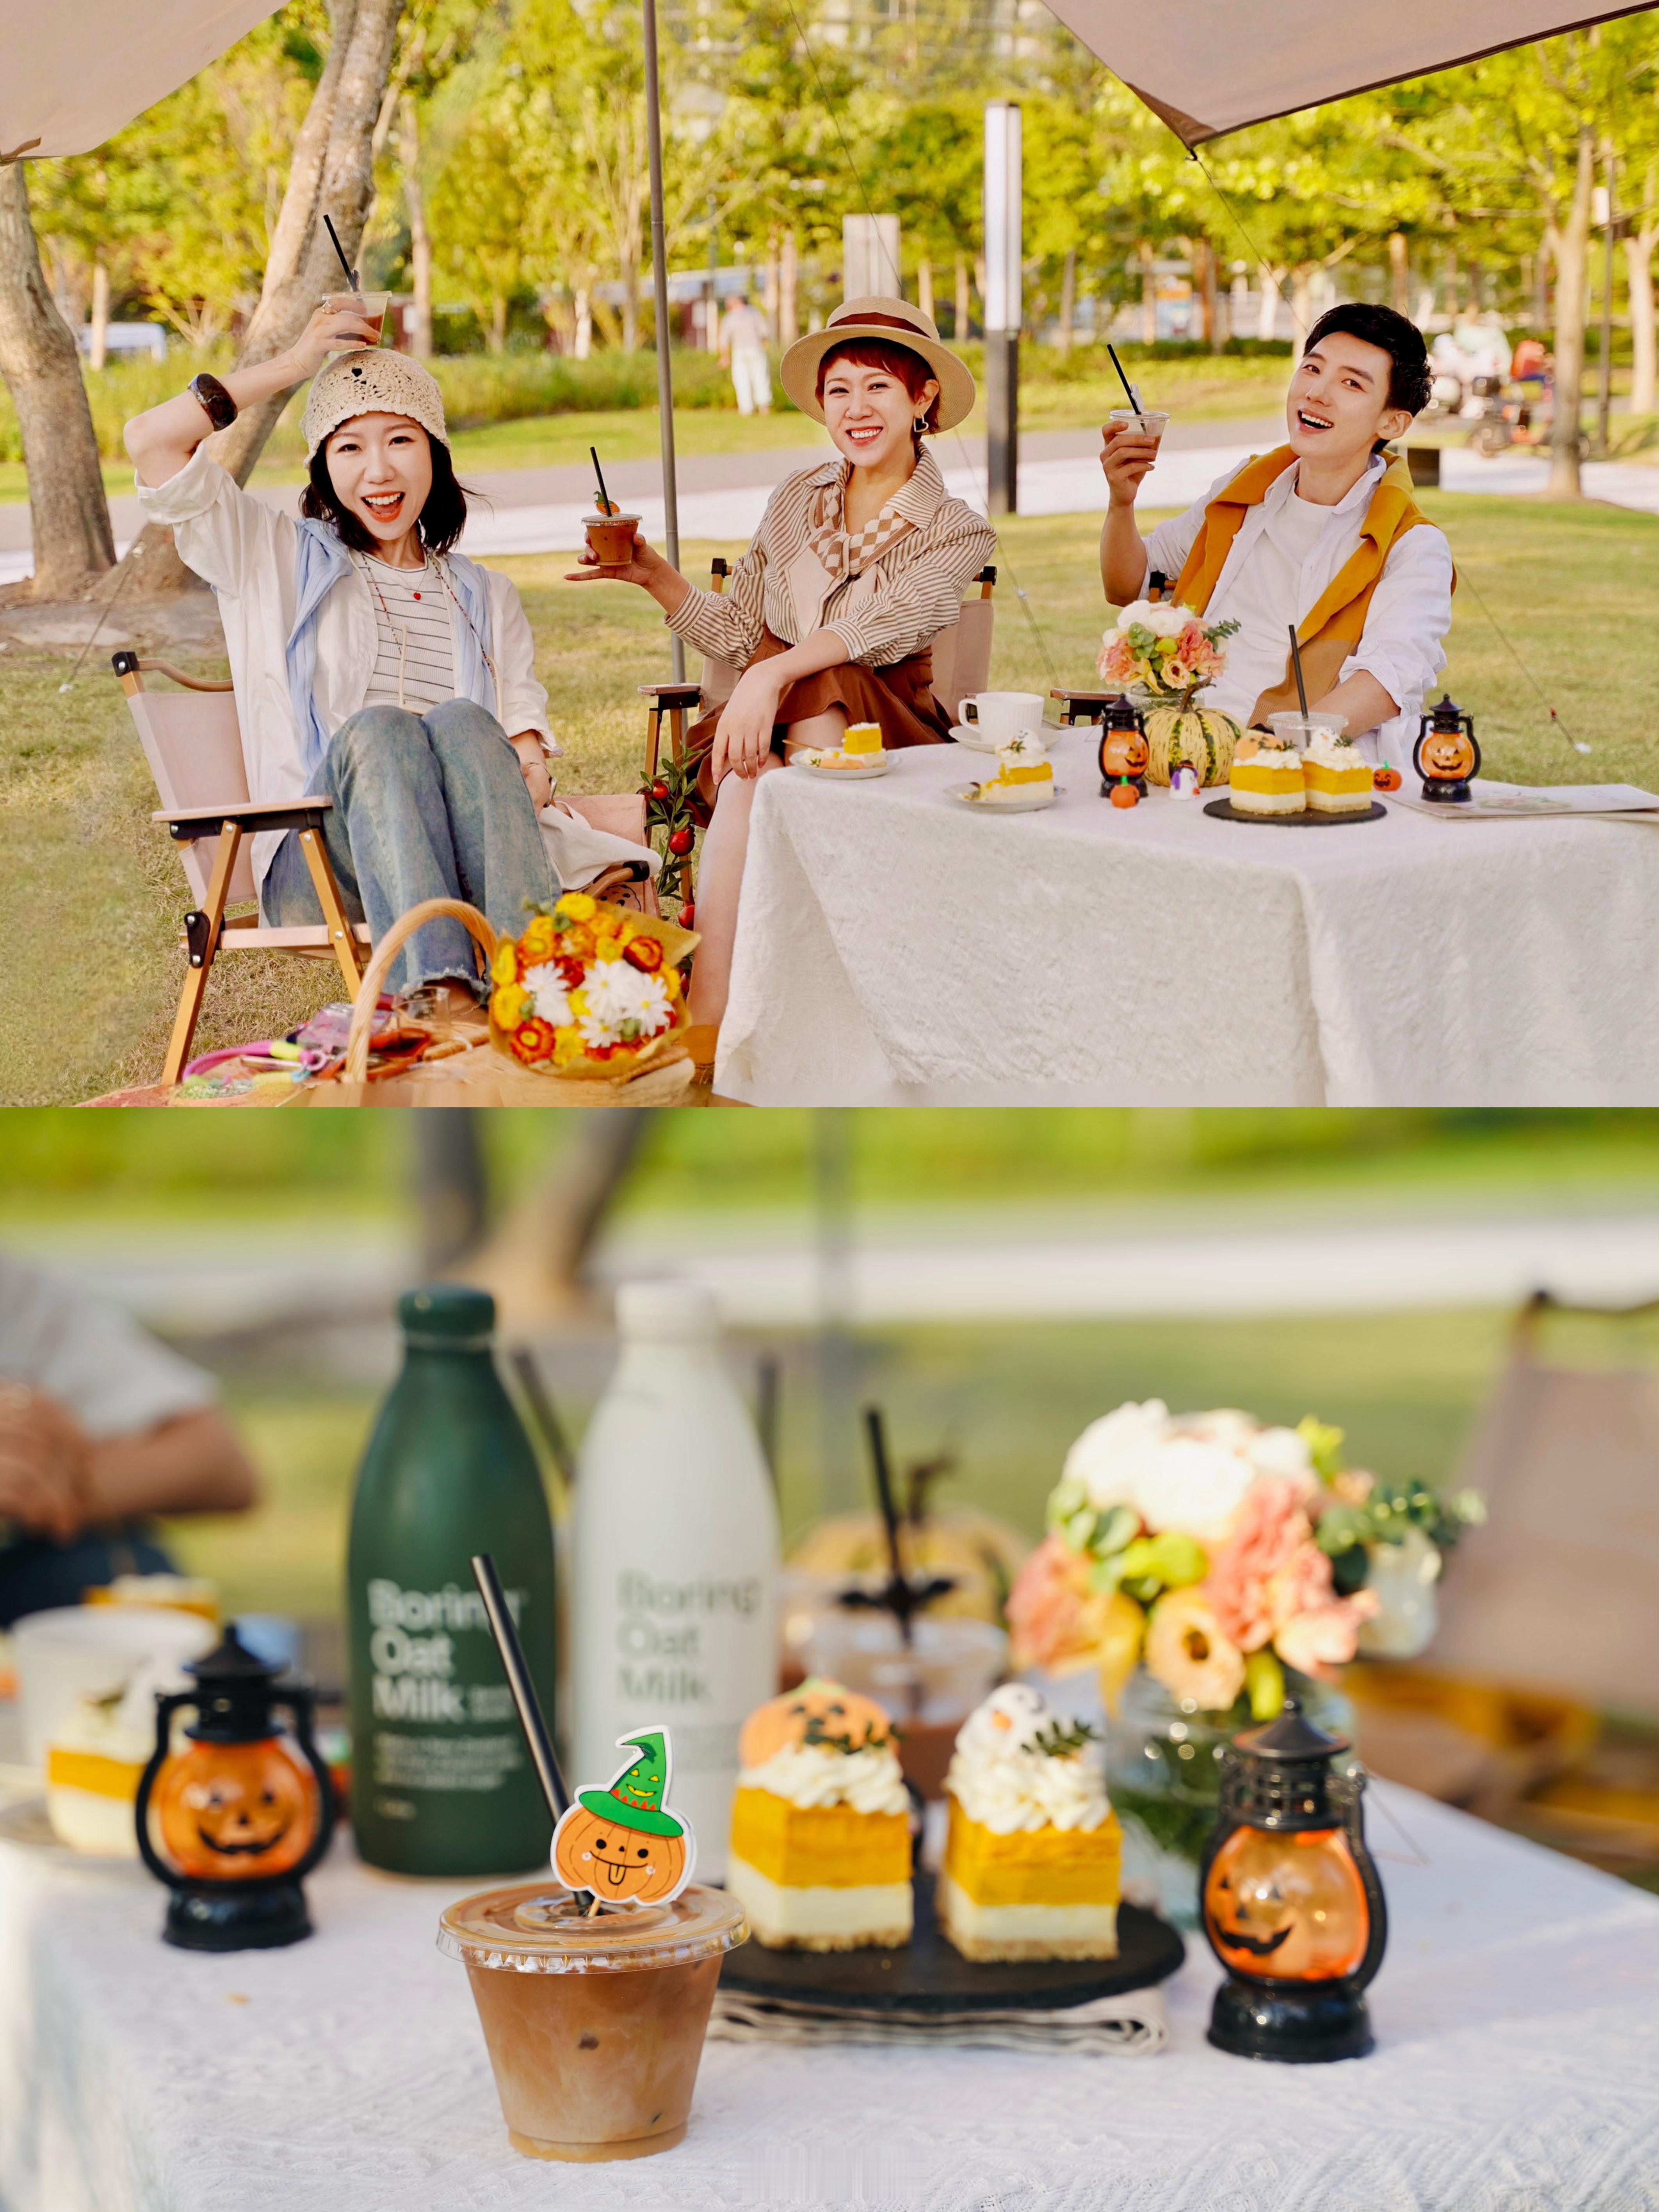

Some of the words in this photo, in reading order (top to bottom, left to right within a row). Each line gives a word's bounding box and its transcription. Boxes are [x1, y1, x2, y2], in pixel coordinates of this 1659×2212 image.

[370, 1626, 456, 1676] Oat
[616, 1616, 700, 1662] Oat
[372, 1675, 466, 1722] Milk
[618, 1663, 710, 1703] Milk
